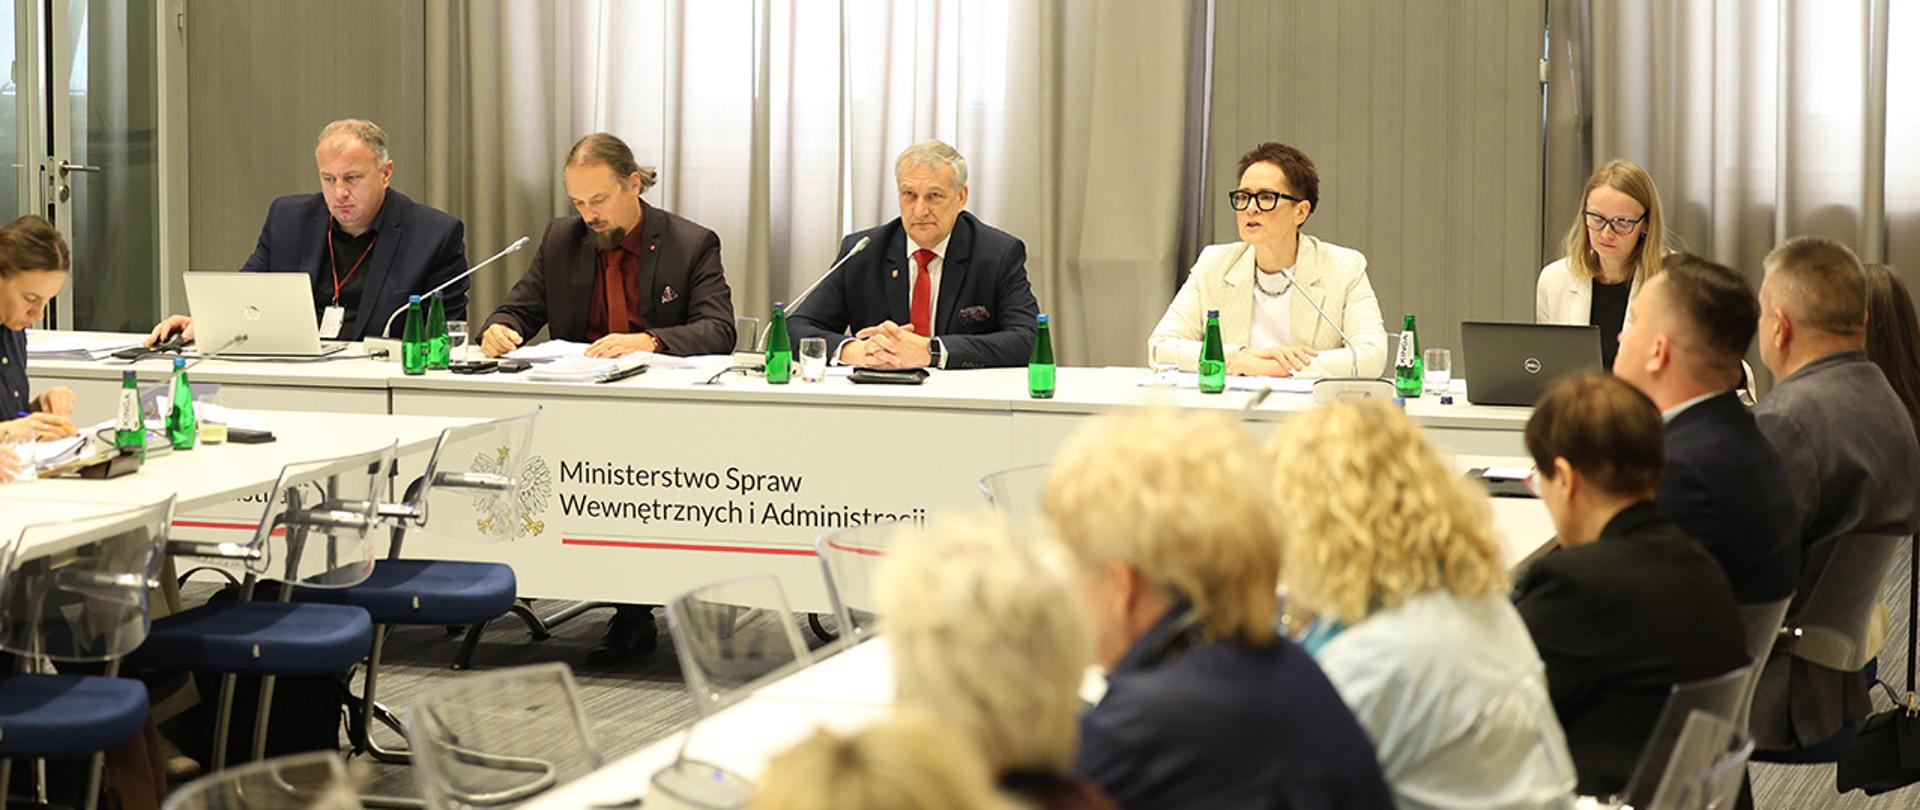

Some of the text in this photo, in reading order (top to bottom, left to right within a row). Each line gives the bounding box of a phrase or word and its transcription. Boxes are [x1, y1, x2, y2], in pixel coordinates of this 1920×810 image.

[560, 460, 802, 496] Ministerstwo Spraw
[559, 493, 742, 527] Wewnętrznych
[749, 501, 754, 525] i
